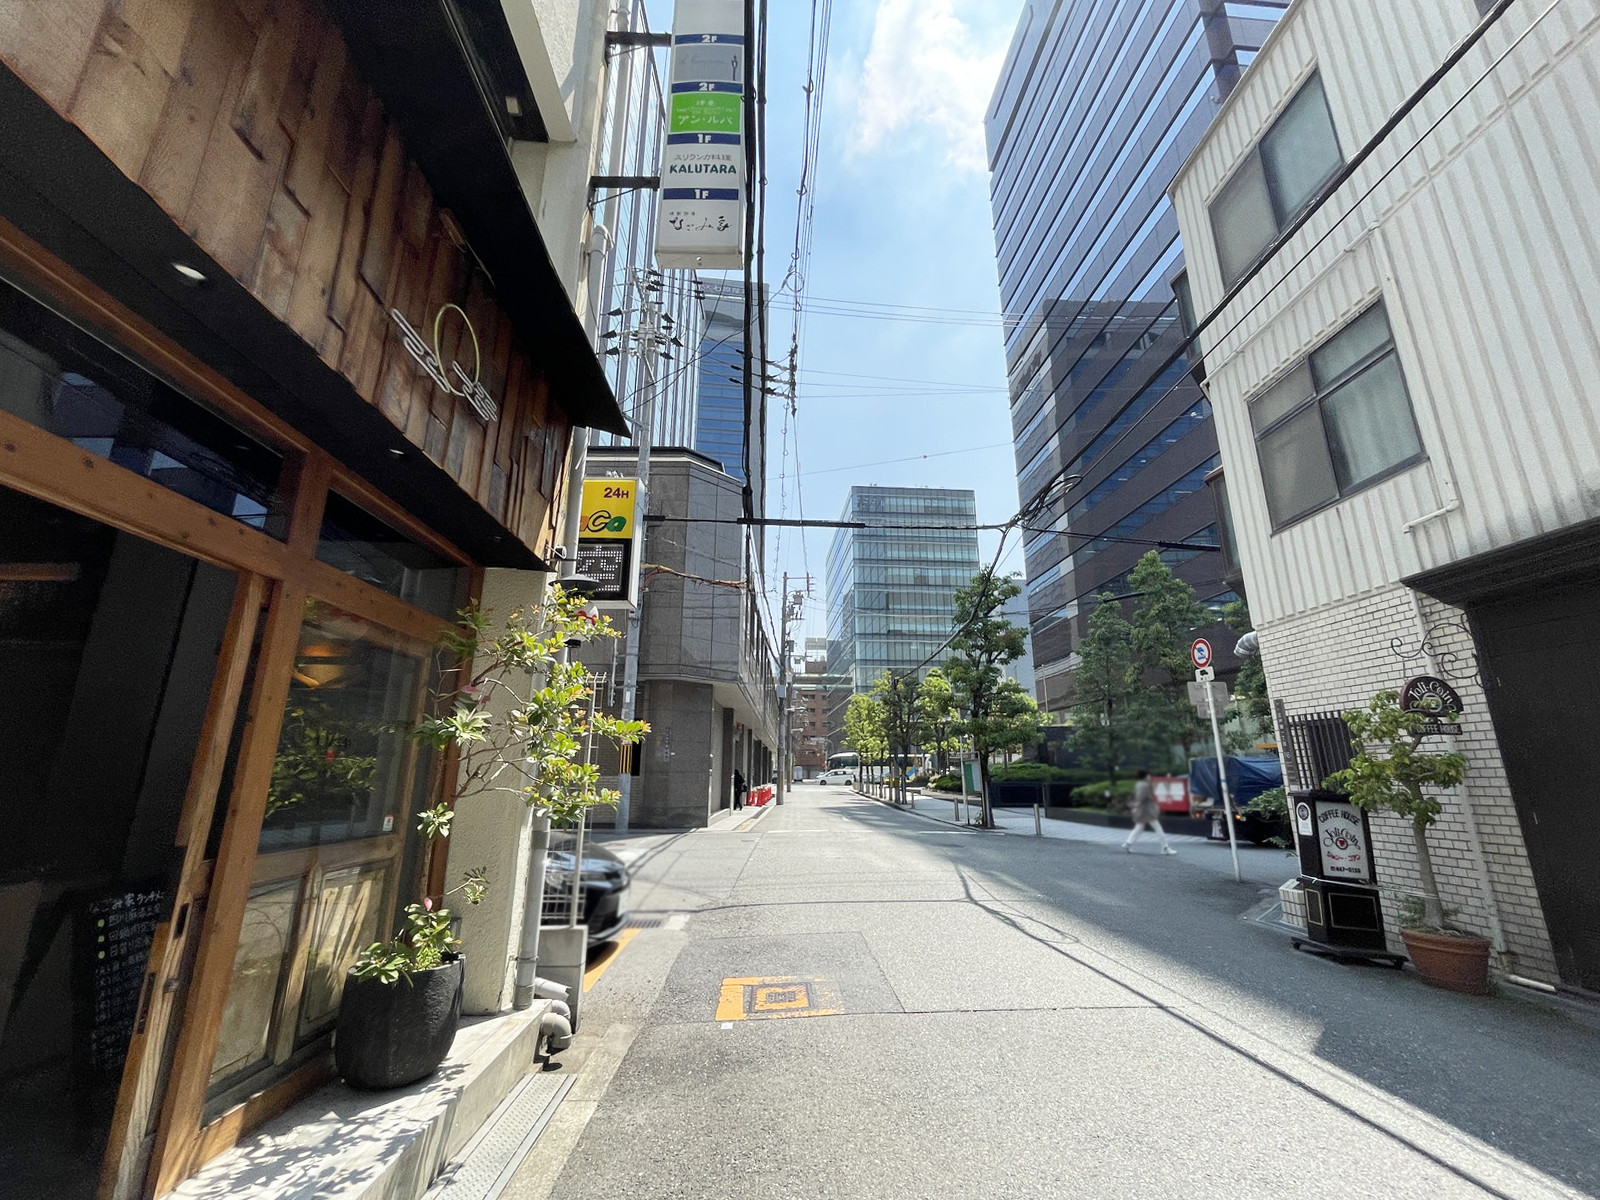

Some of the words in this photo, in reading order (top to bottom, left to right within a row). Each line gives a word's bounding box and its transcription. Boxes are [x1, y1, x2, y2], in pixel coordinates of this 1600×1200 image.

[701, 34, 718, 43] 2F
[698, 82, 715, 91] 2F
[697, 134, 711, 143] 1F
[674, 153, 733, 162] スリランカ料理
[669, 163, 737, 175] KALUTARA
[694, 188, 709, 199] 1F
[603, 486, 630, 499] 24H
[1415, 724, 1439, 734] OFFEE
[1318, 809, 1340, 823] COFFEE
[1341, 810, 1361, 826] HOUSE
